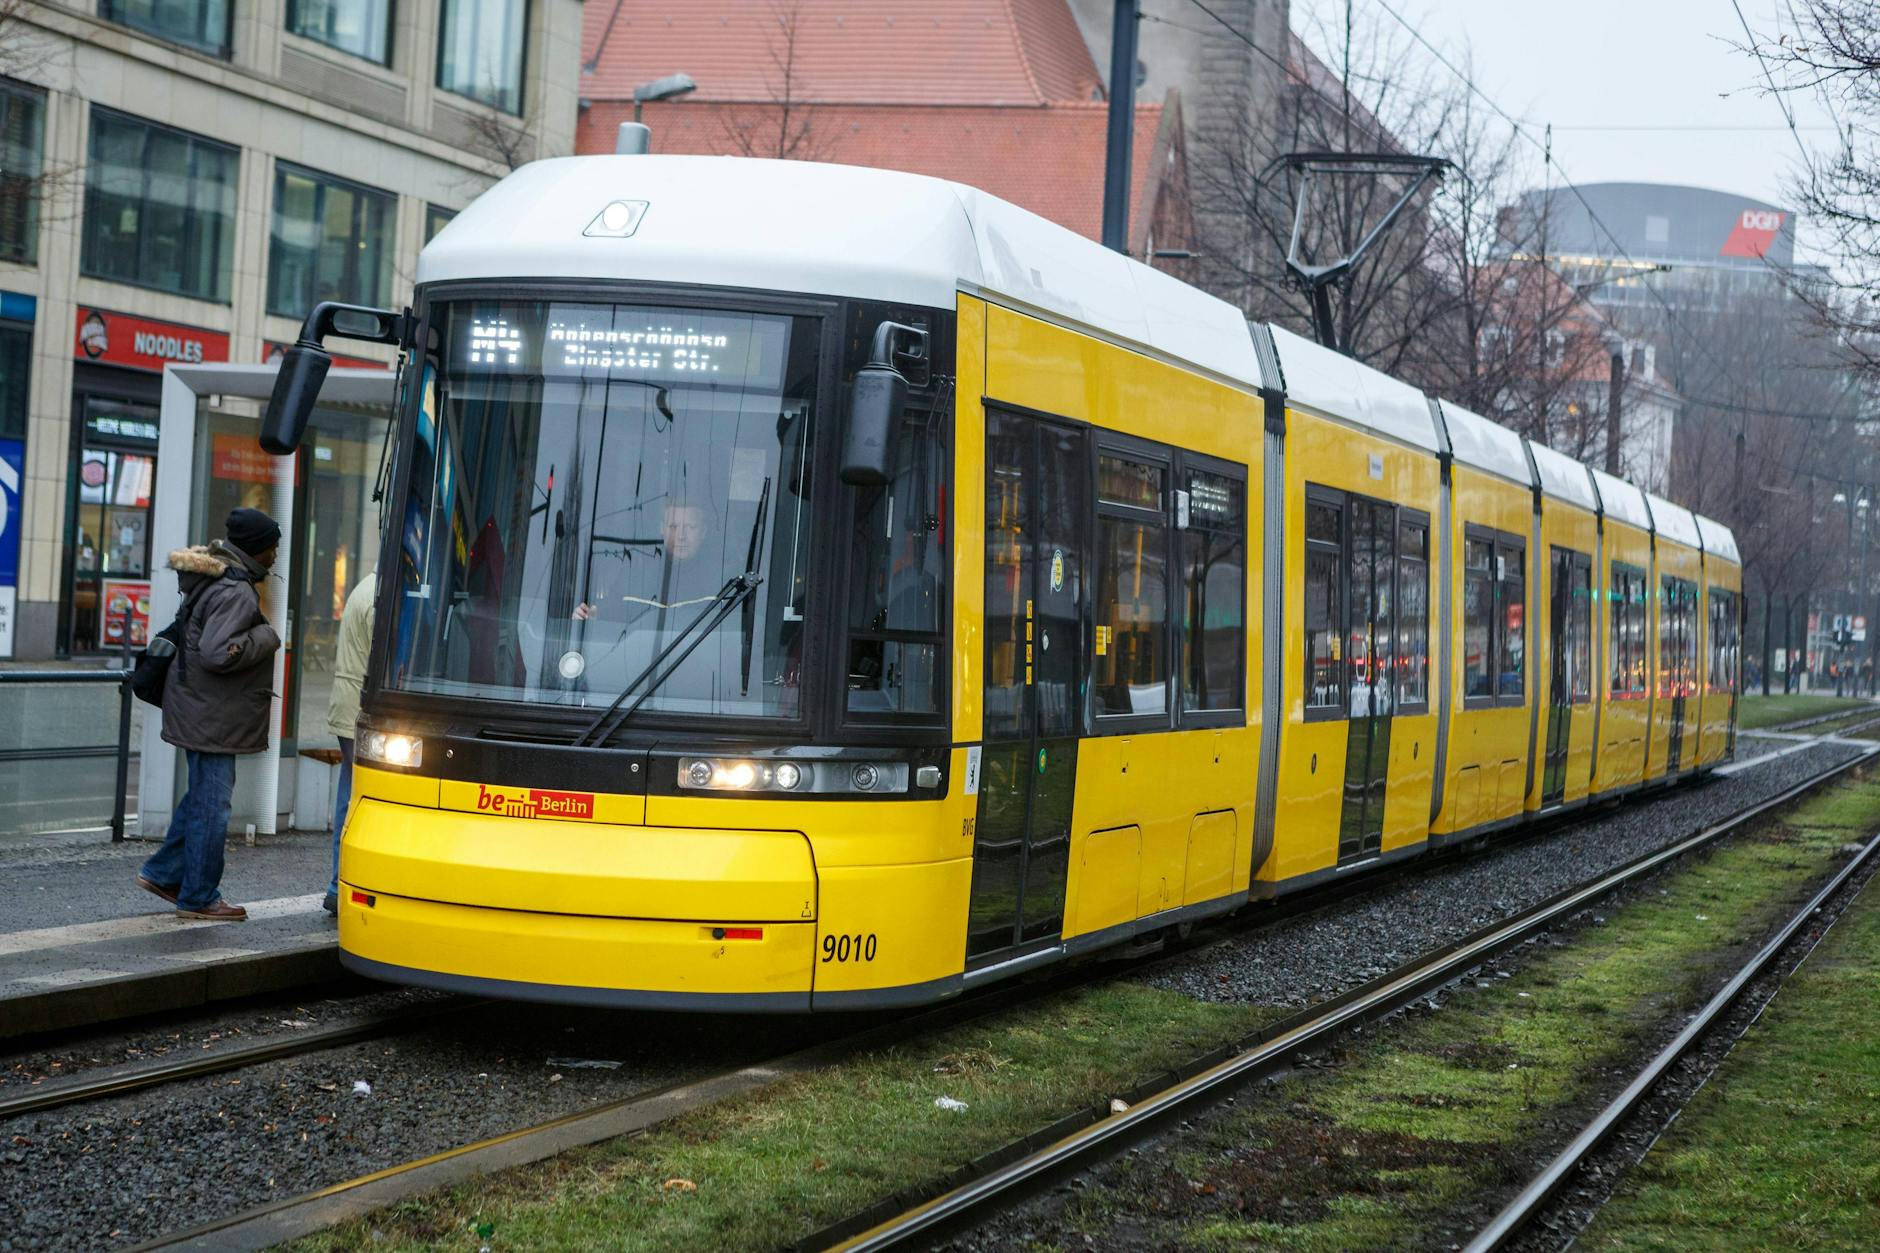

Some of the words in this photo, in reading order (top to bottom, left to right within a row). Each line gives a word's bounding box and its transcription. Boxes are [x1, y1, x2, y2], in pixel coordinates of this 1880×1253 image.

[134, 332, 203, 362] NOODLES
[540, 796, 588, 814] Berlin
[962, 817, 975, 837] BVG
[822, 933, 877, 963] 9010
